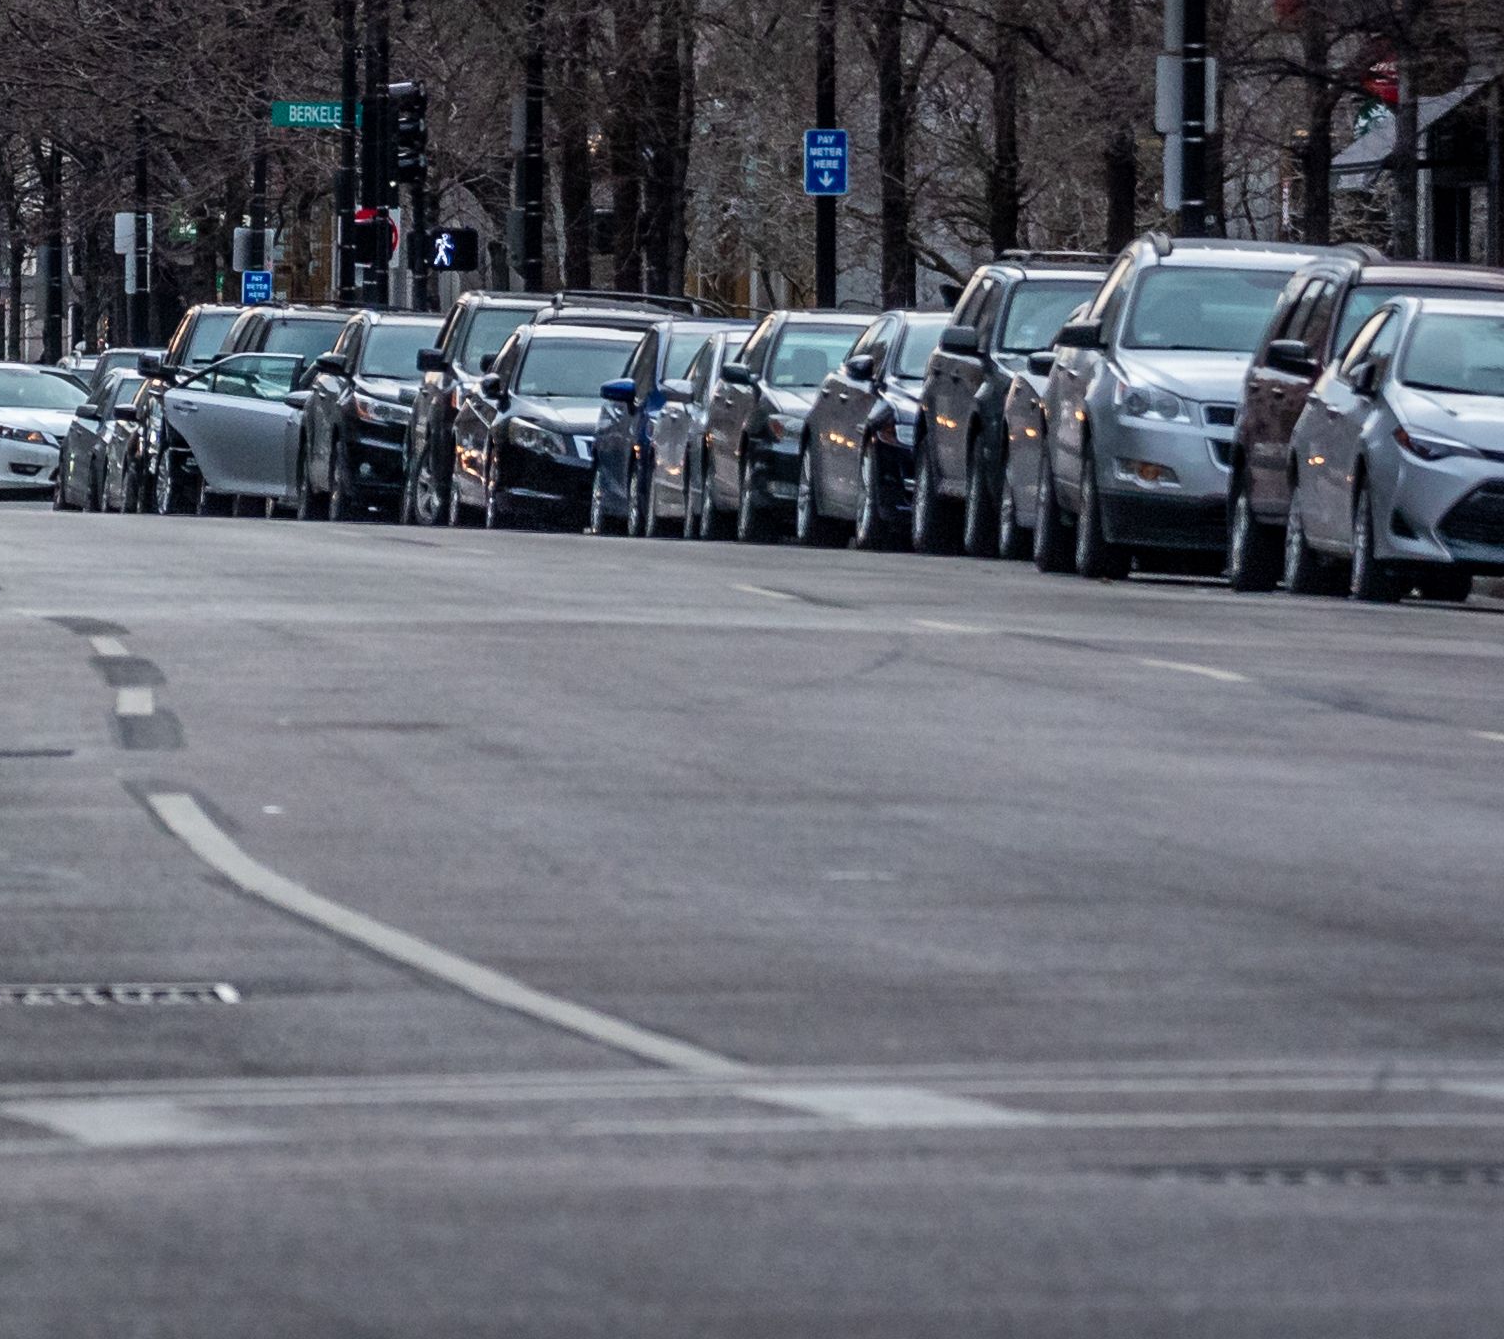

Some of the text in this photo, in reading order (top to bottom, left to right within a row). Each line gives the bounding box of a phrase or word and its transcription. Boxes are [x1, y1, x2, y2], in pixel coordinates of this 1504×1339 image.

[288, 105, 342, 123] BERKELE
[816, 134, 836, 145] PAY
[808, 147, 844, 157] METER
[812, 159, 840, 170] HERE
